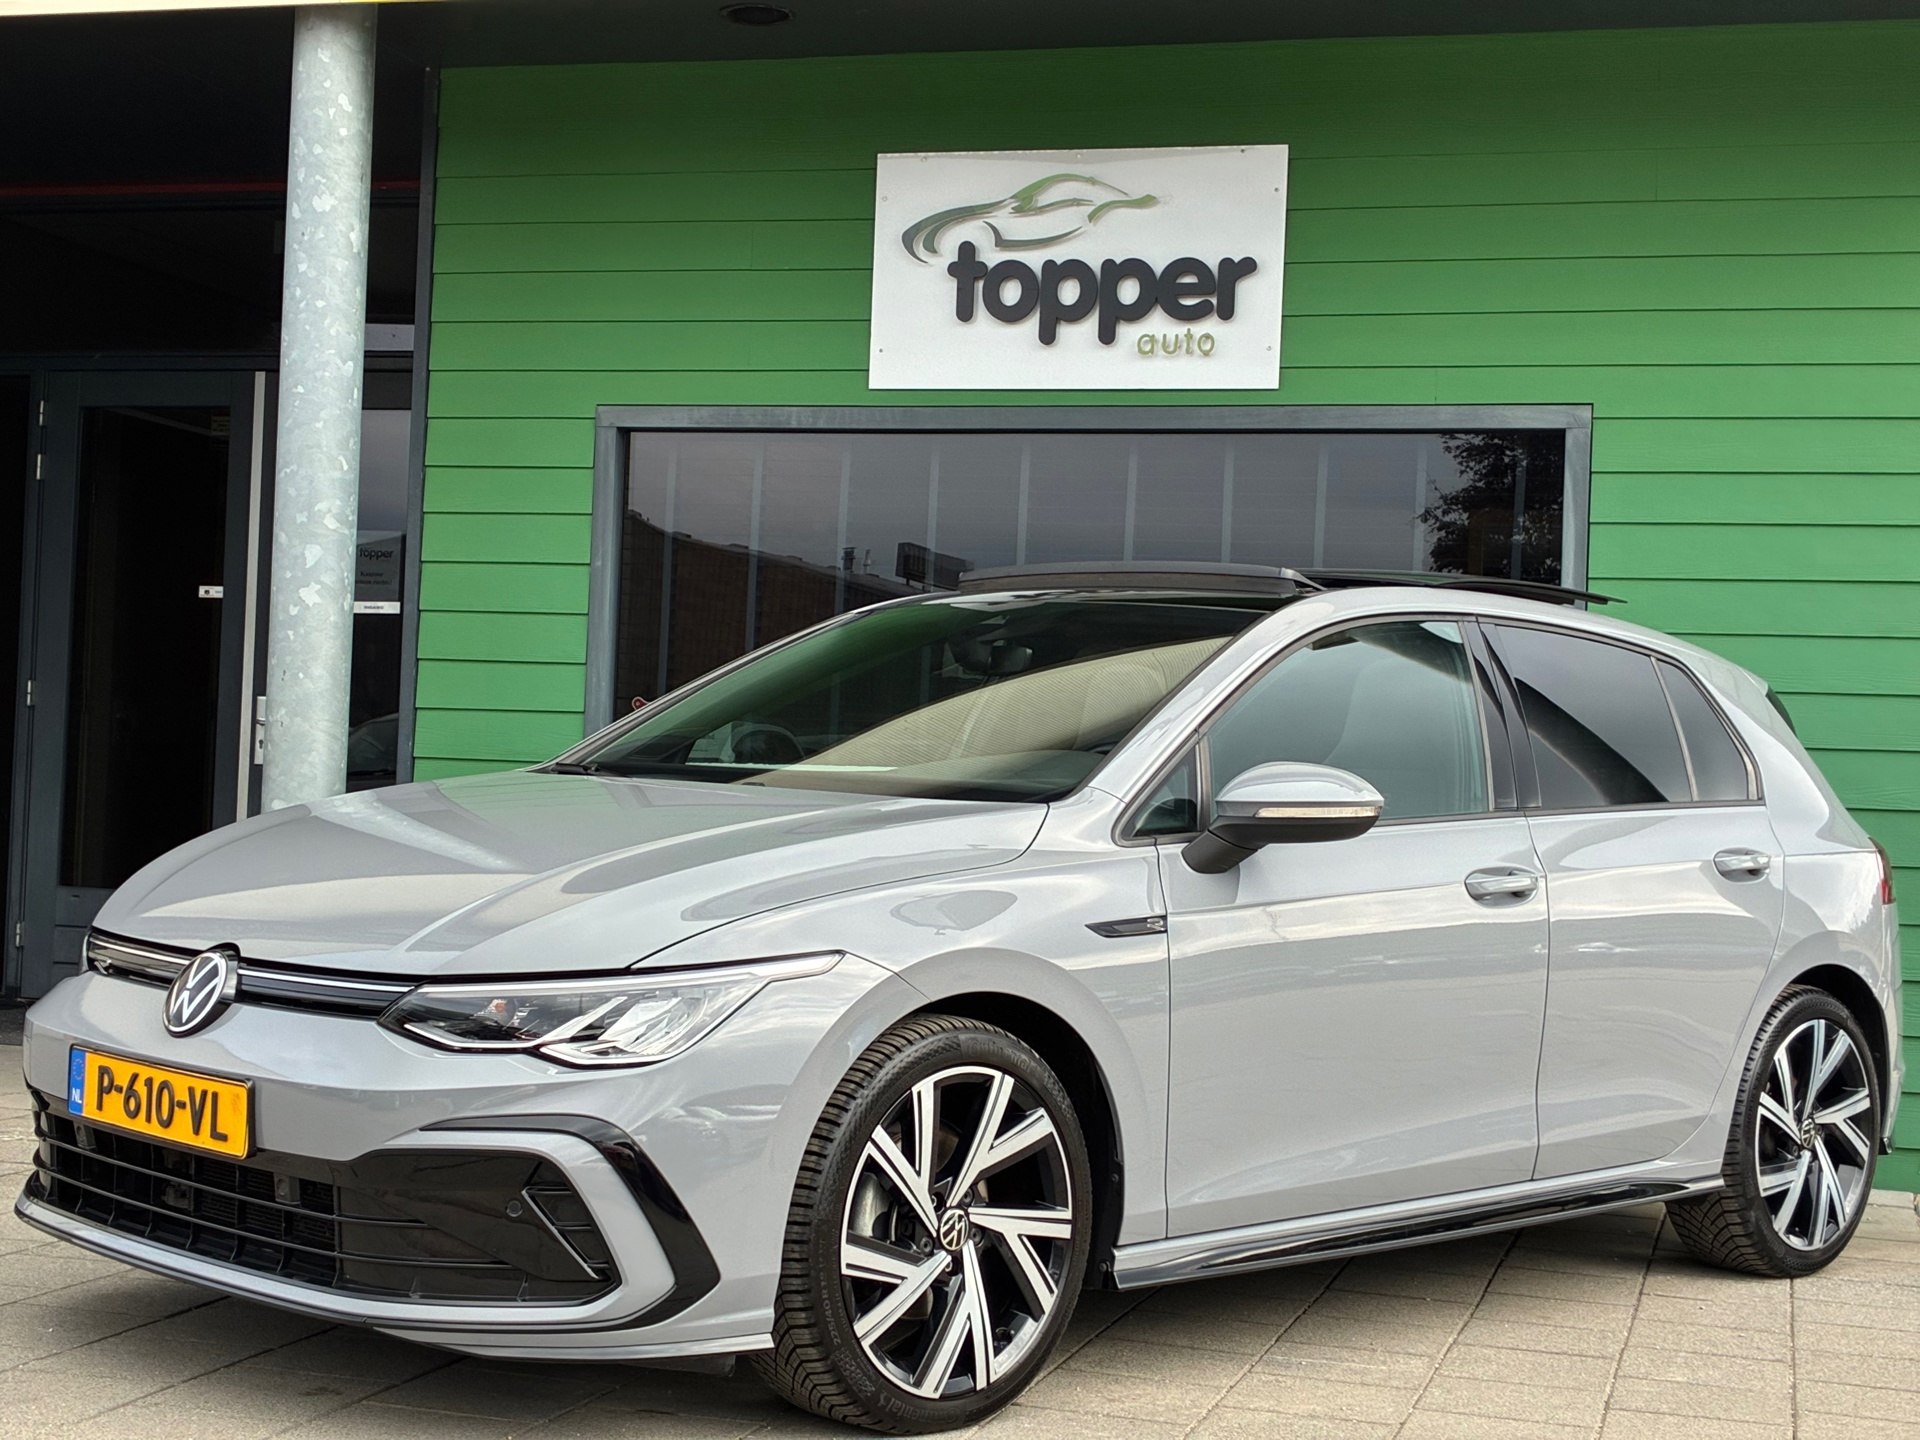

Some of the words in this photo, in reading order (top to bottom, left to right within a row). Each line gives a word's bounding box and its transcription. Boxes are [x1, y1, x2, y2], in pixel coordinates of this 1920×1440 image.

[947, 240, 1258, 346] topper
[1136, 327, 1216, 357] auto
[359, 547, 394, 560] topper
[71, 1087, 82, 1104] NL
[96, 1065, 229, 1143] P-610-VL
